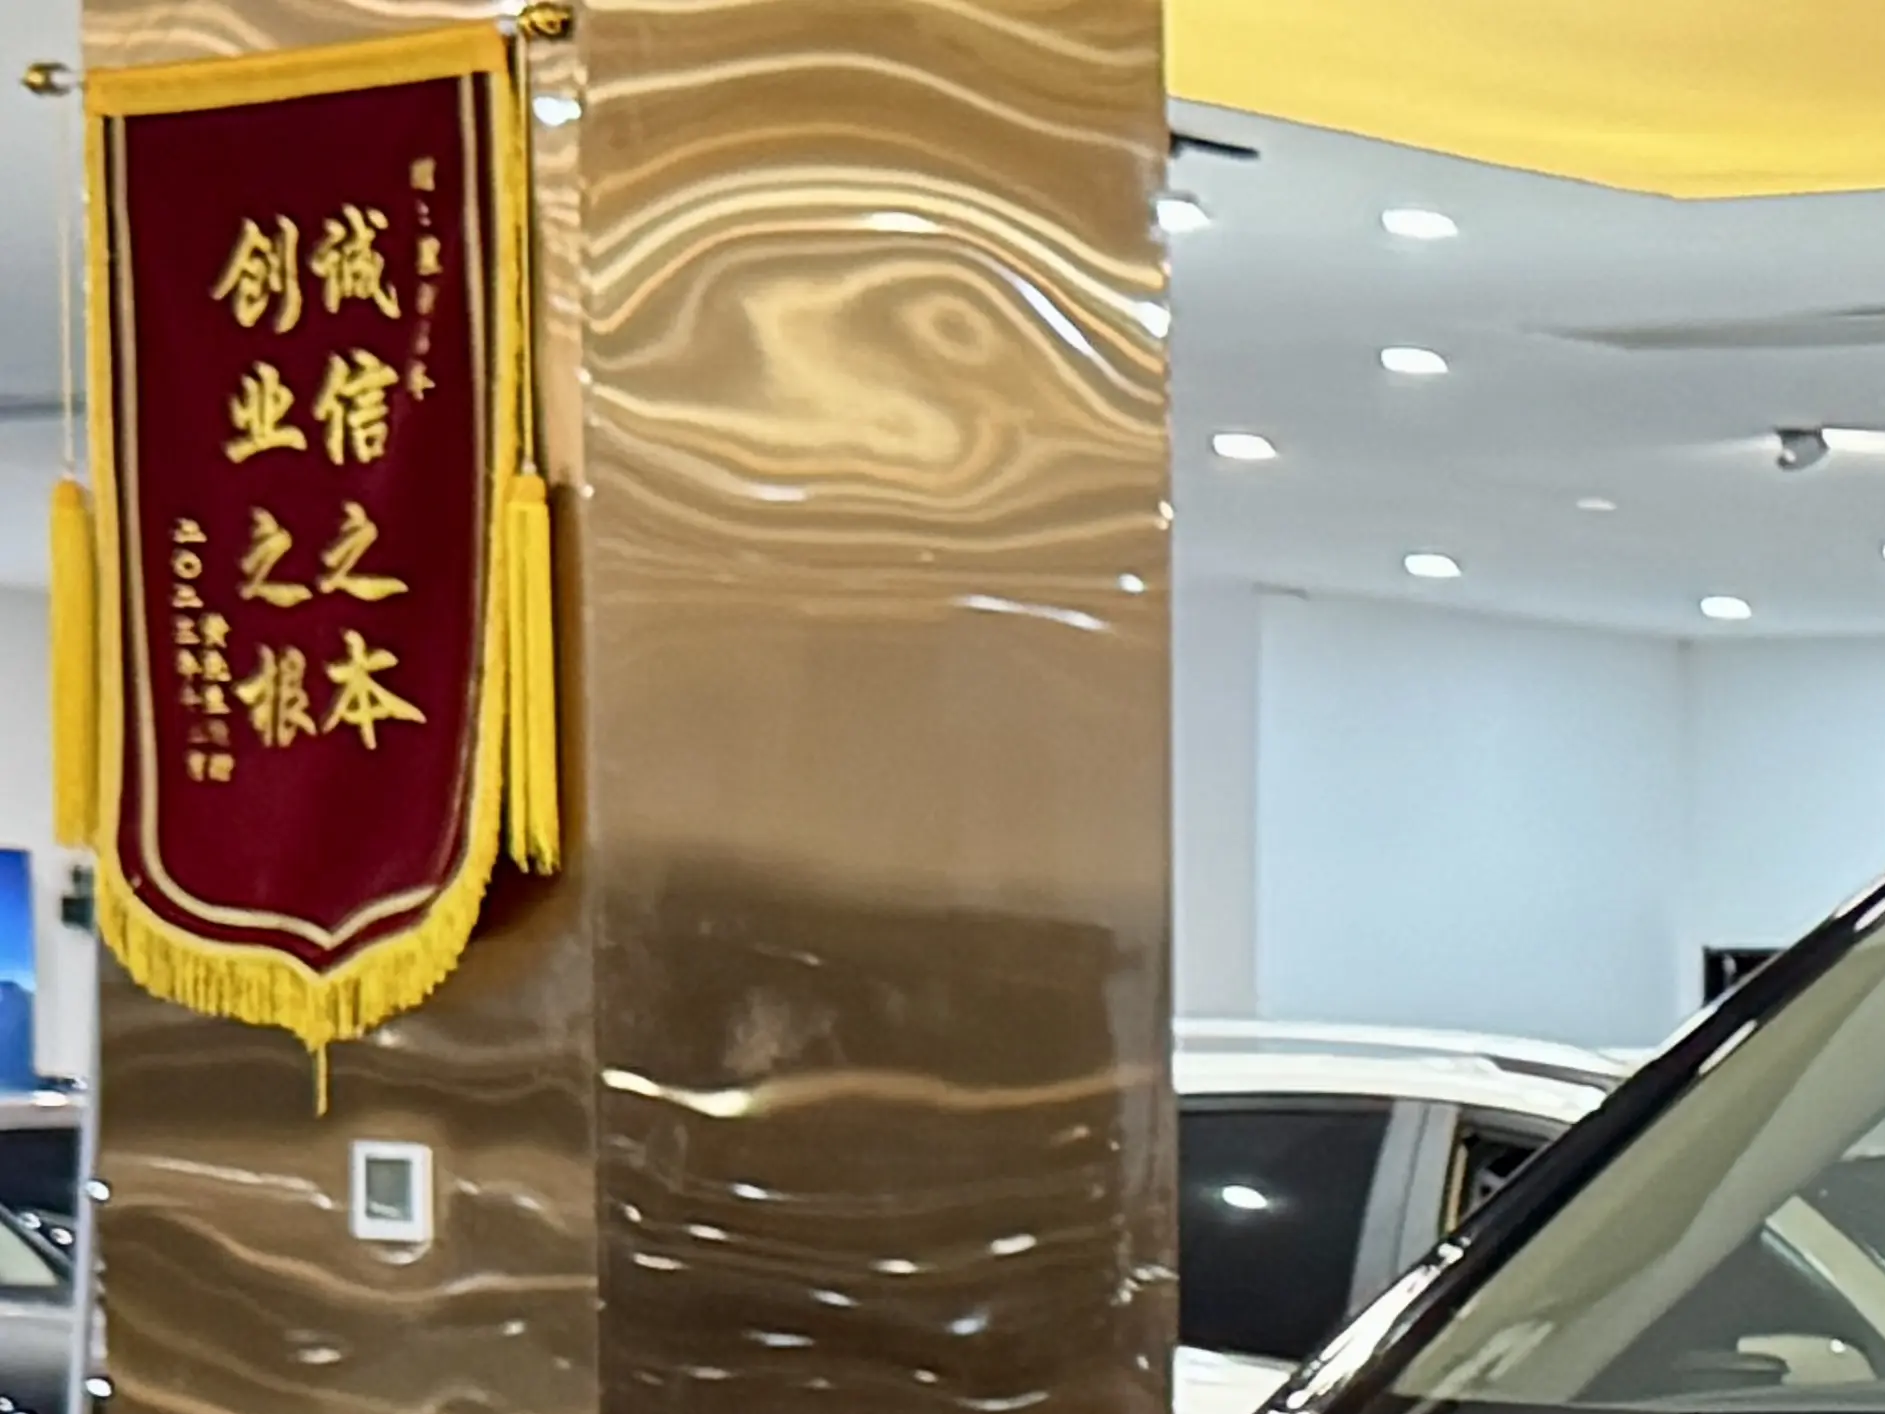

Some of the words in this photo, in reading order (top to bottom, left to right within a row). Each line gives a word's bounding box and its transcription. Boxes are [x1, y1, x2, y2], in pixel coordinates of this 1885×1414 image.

[211, 213, 318, 748] 创业之根
[311, 202, 427, 750] 诚信之本
